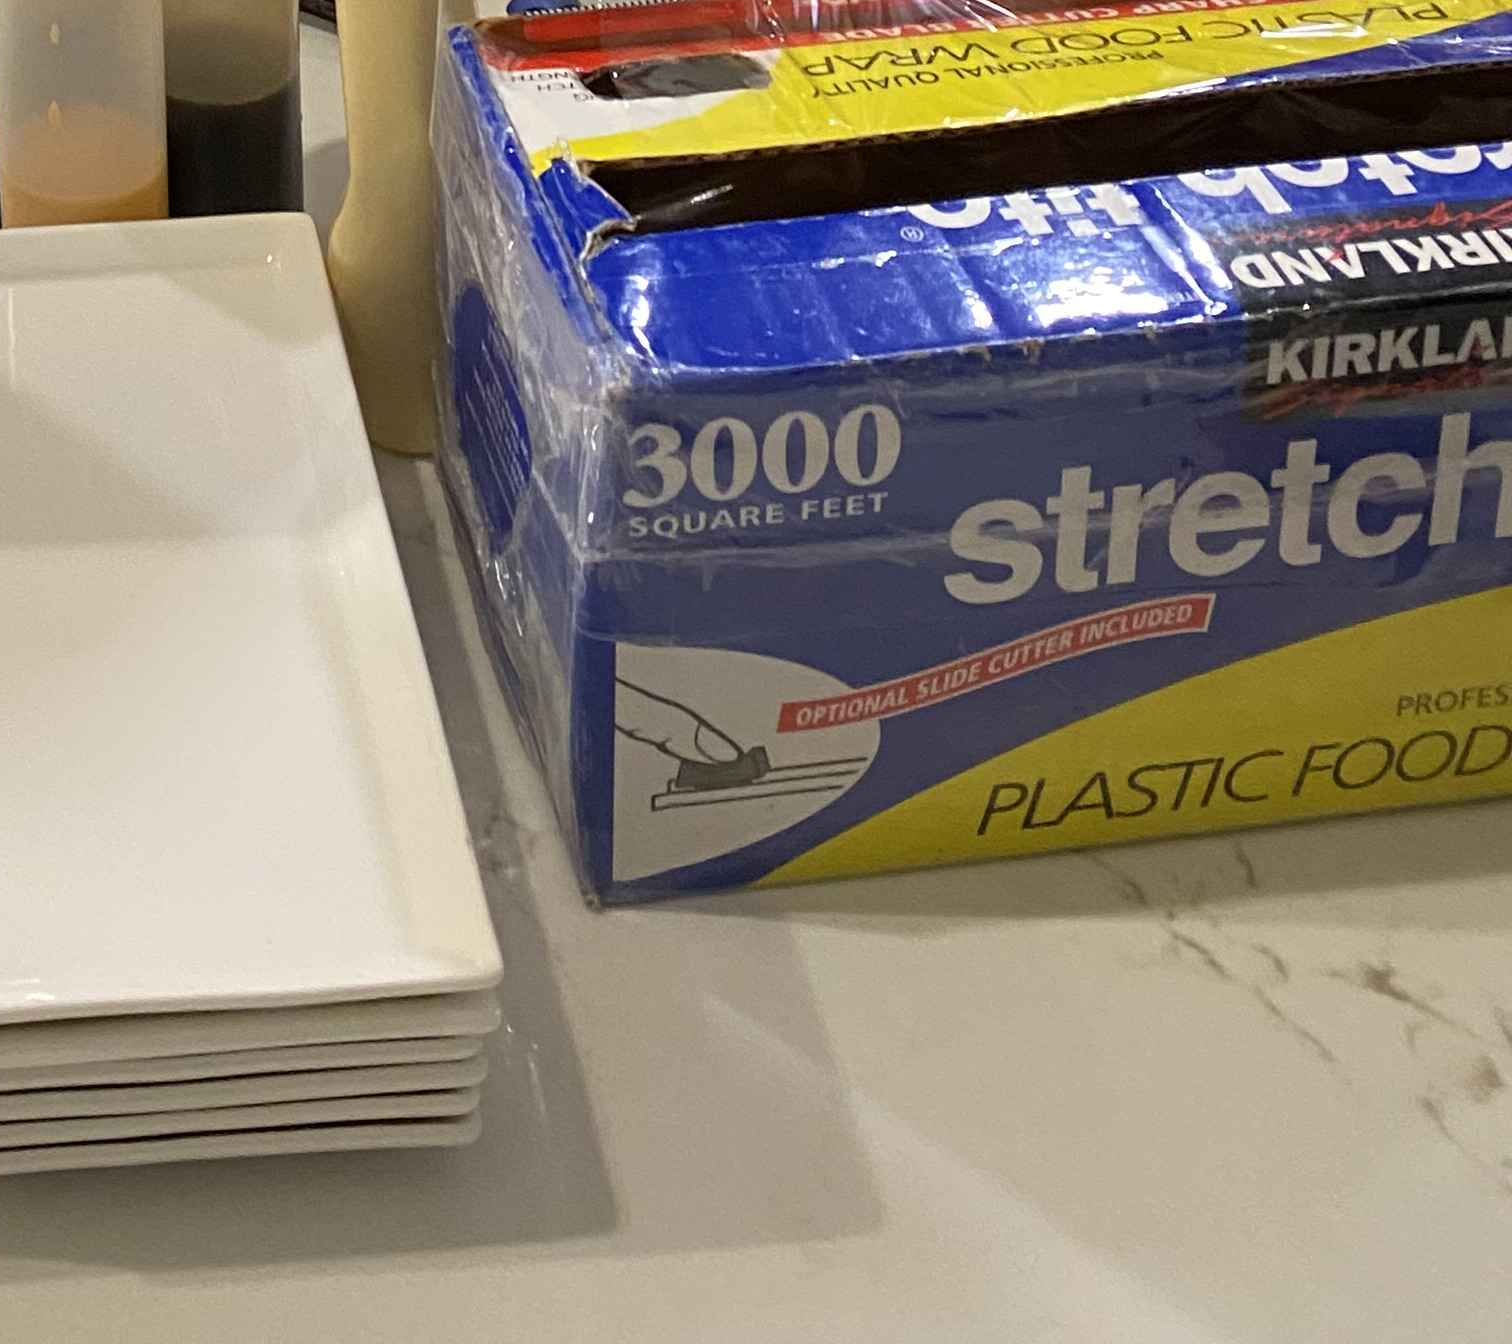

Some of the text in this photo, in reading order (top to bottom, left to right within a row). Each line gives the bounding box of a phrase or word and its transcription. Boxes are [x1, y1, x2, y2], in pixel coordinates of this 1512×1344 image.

[801, 42, 1001, 77] WRAP
[1010, 24, 1194, 54] FOOD
[811, 51, 1165, 99] PROFESSIONAL QUALITY
[621, 403, 902, 508] 3000
[628, 490, 889, 539] SQUARE FEET
[795, 603, 1193, 729] OPTIONAL SLIDE CUTTER INCLUDED
[976, 723, 1512, 836] PLASTIC FOOD
